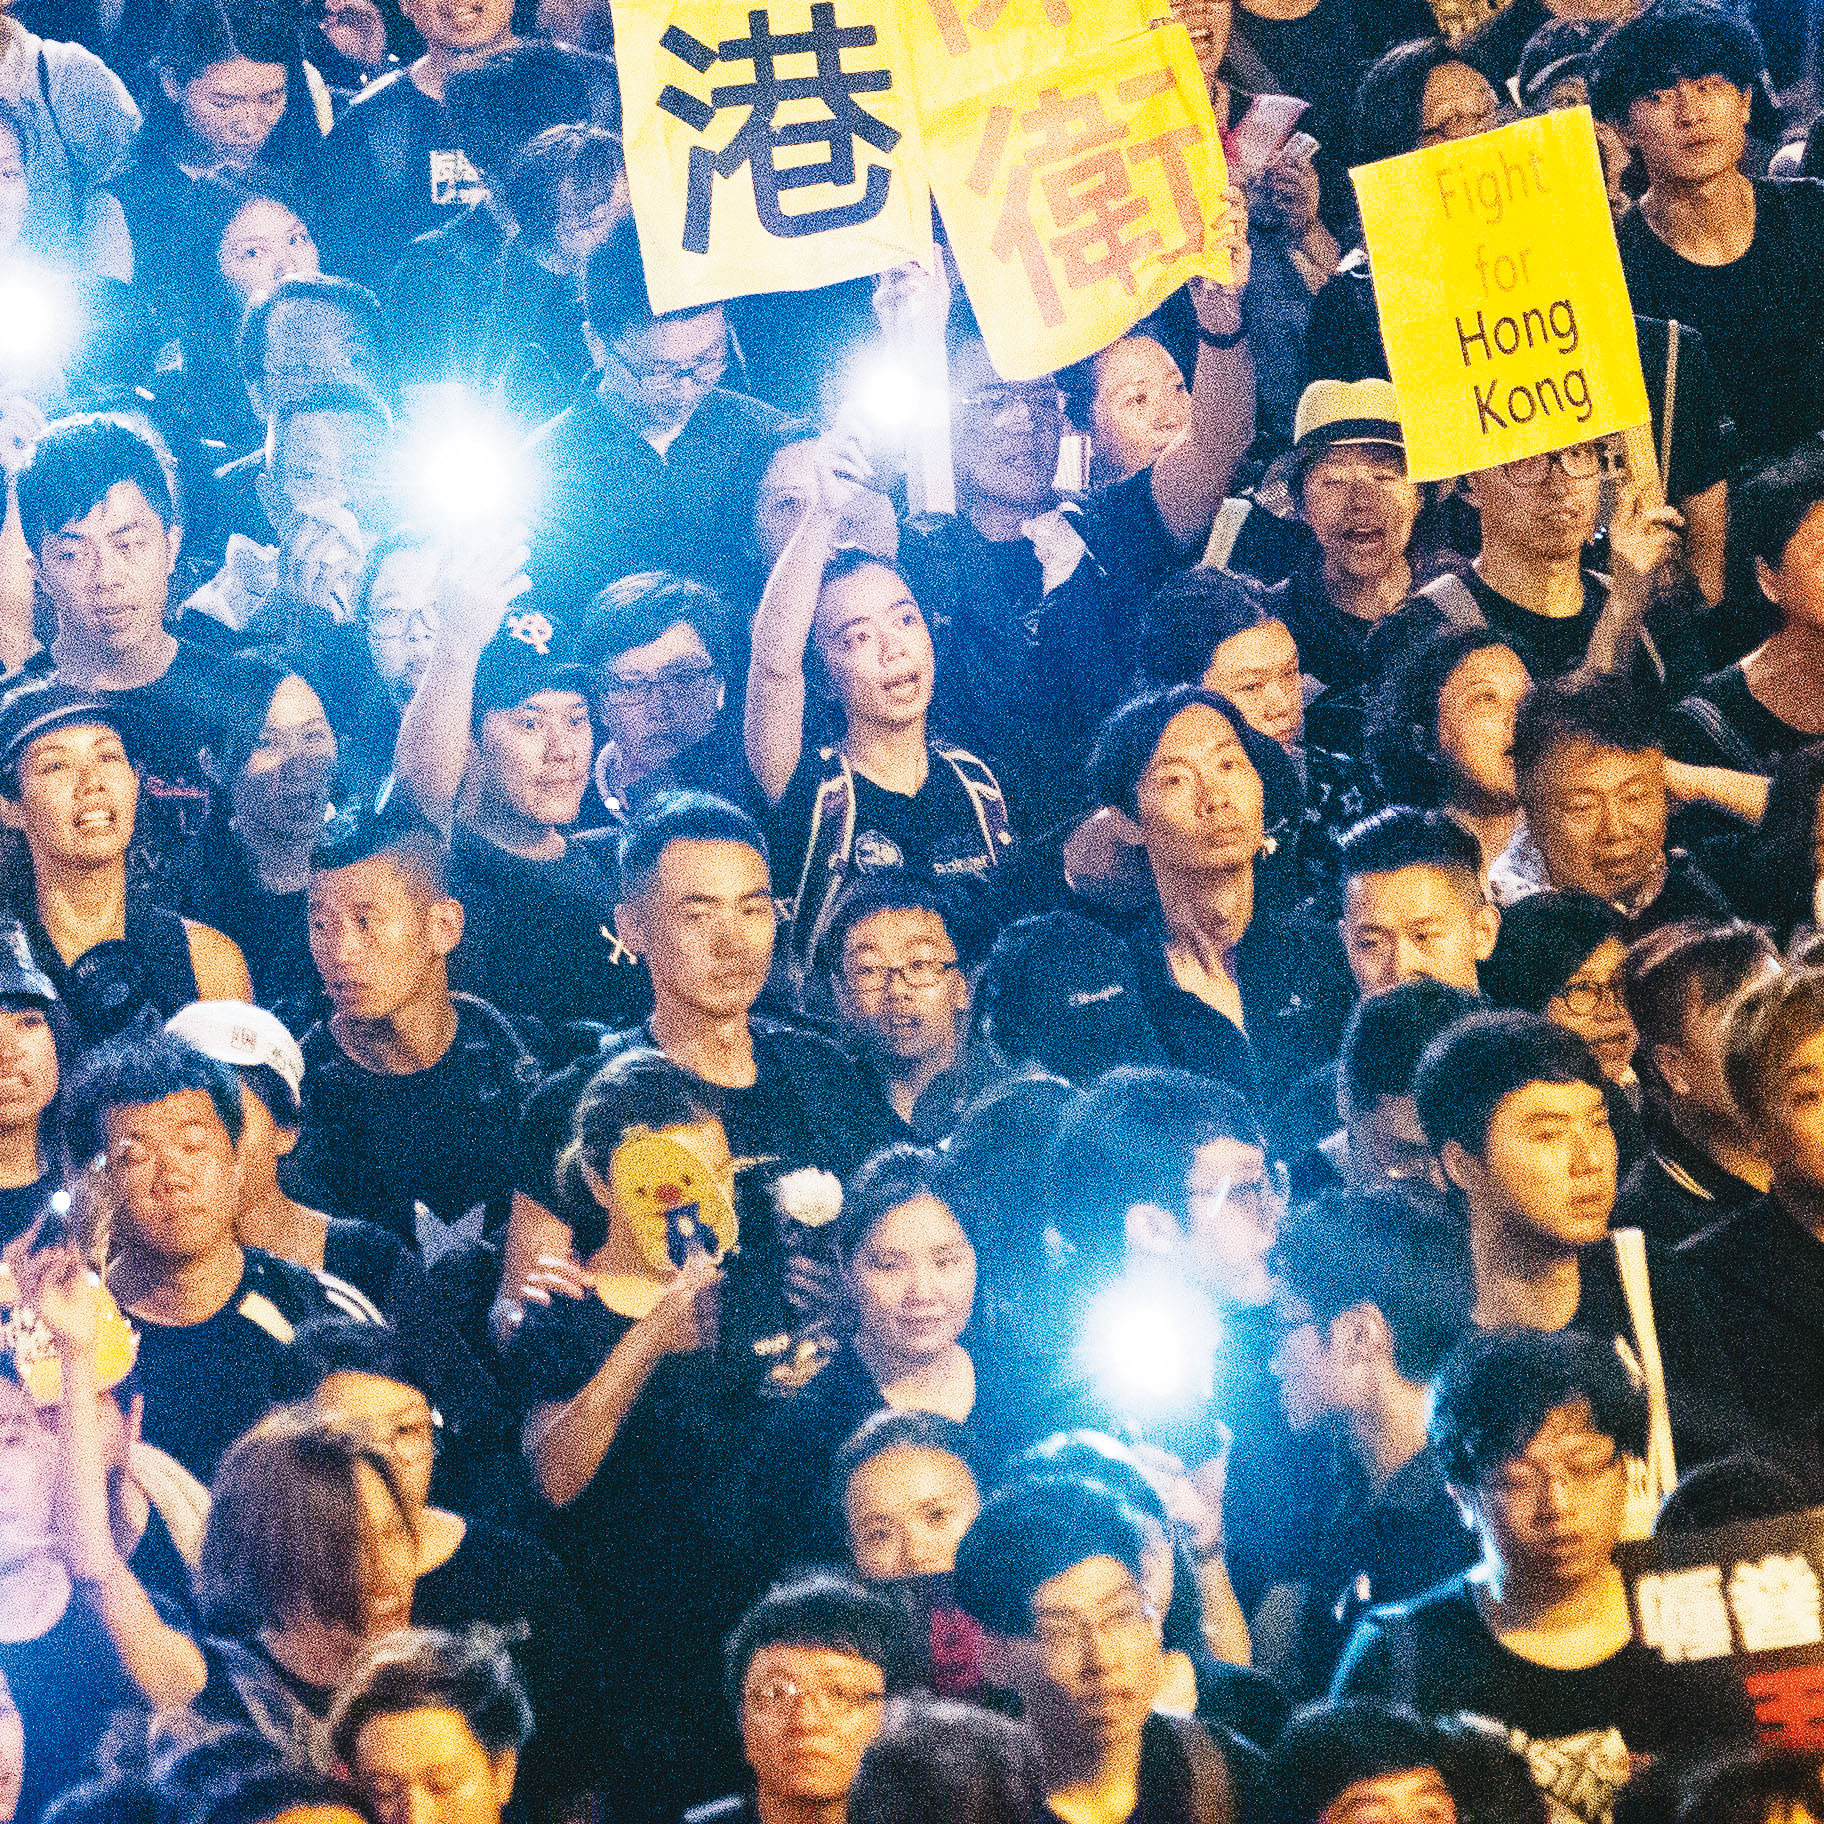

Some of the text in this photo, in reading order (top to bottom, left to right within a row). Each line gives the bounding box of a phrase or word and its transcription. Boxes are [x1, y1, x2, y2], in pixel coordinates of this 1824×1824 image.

[1434, 150, 1550, 224] Fight
[1474, 242, 1533, 297] for
[1455, 298, 1581, 366] Hong
[1473, 368, 1595, 434] Kong
